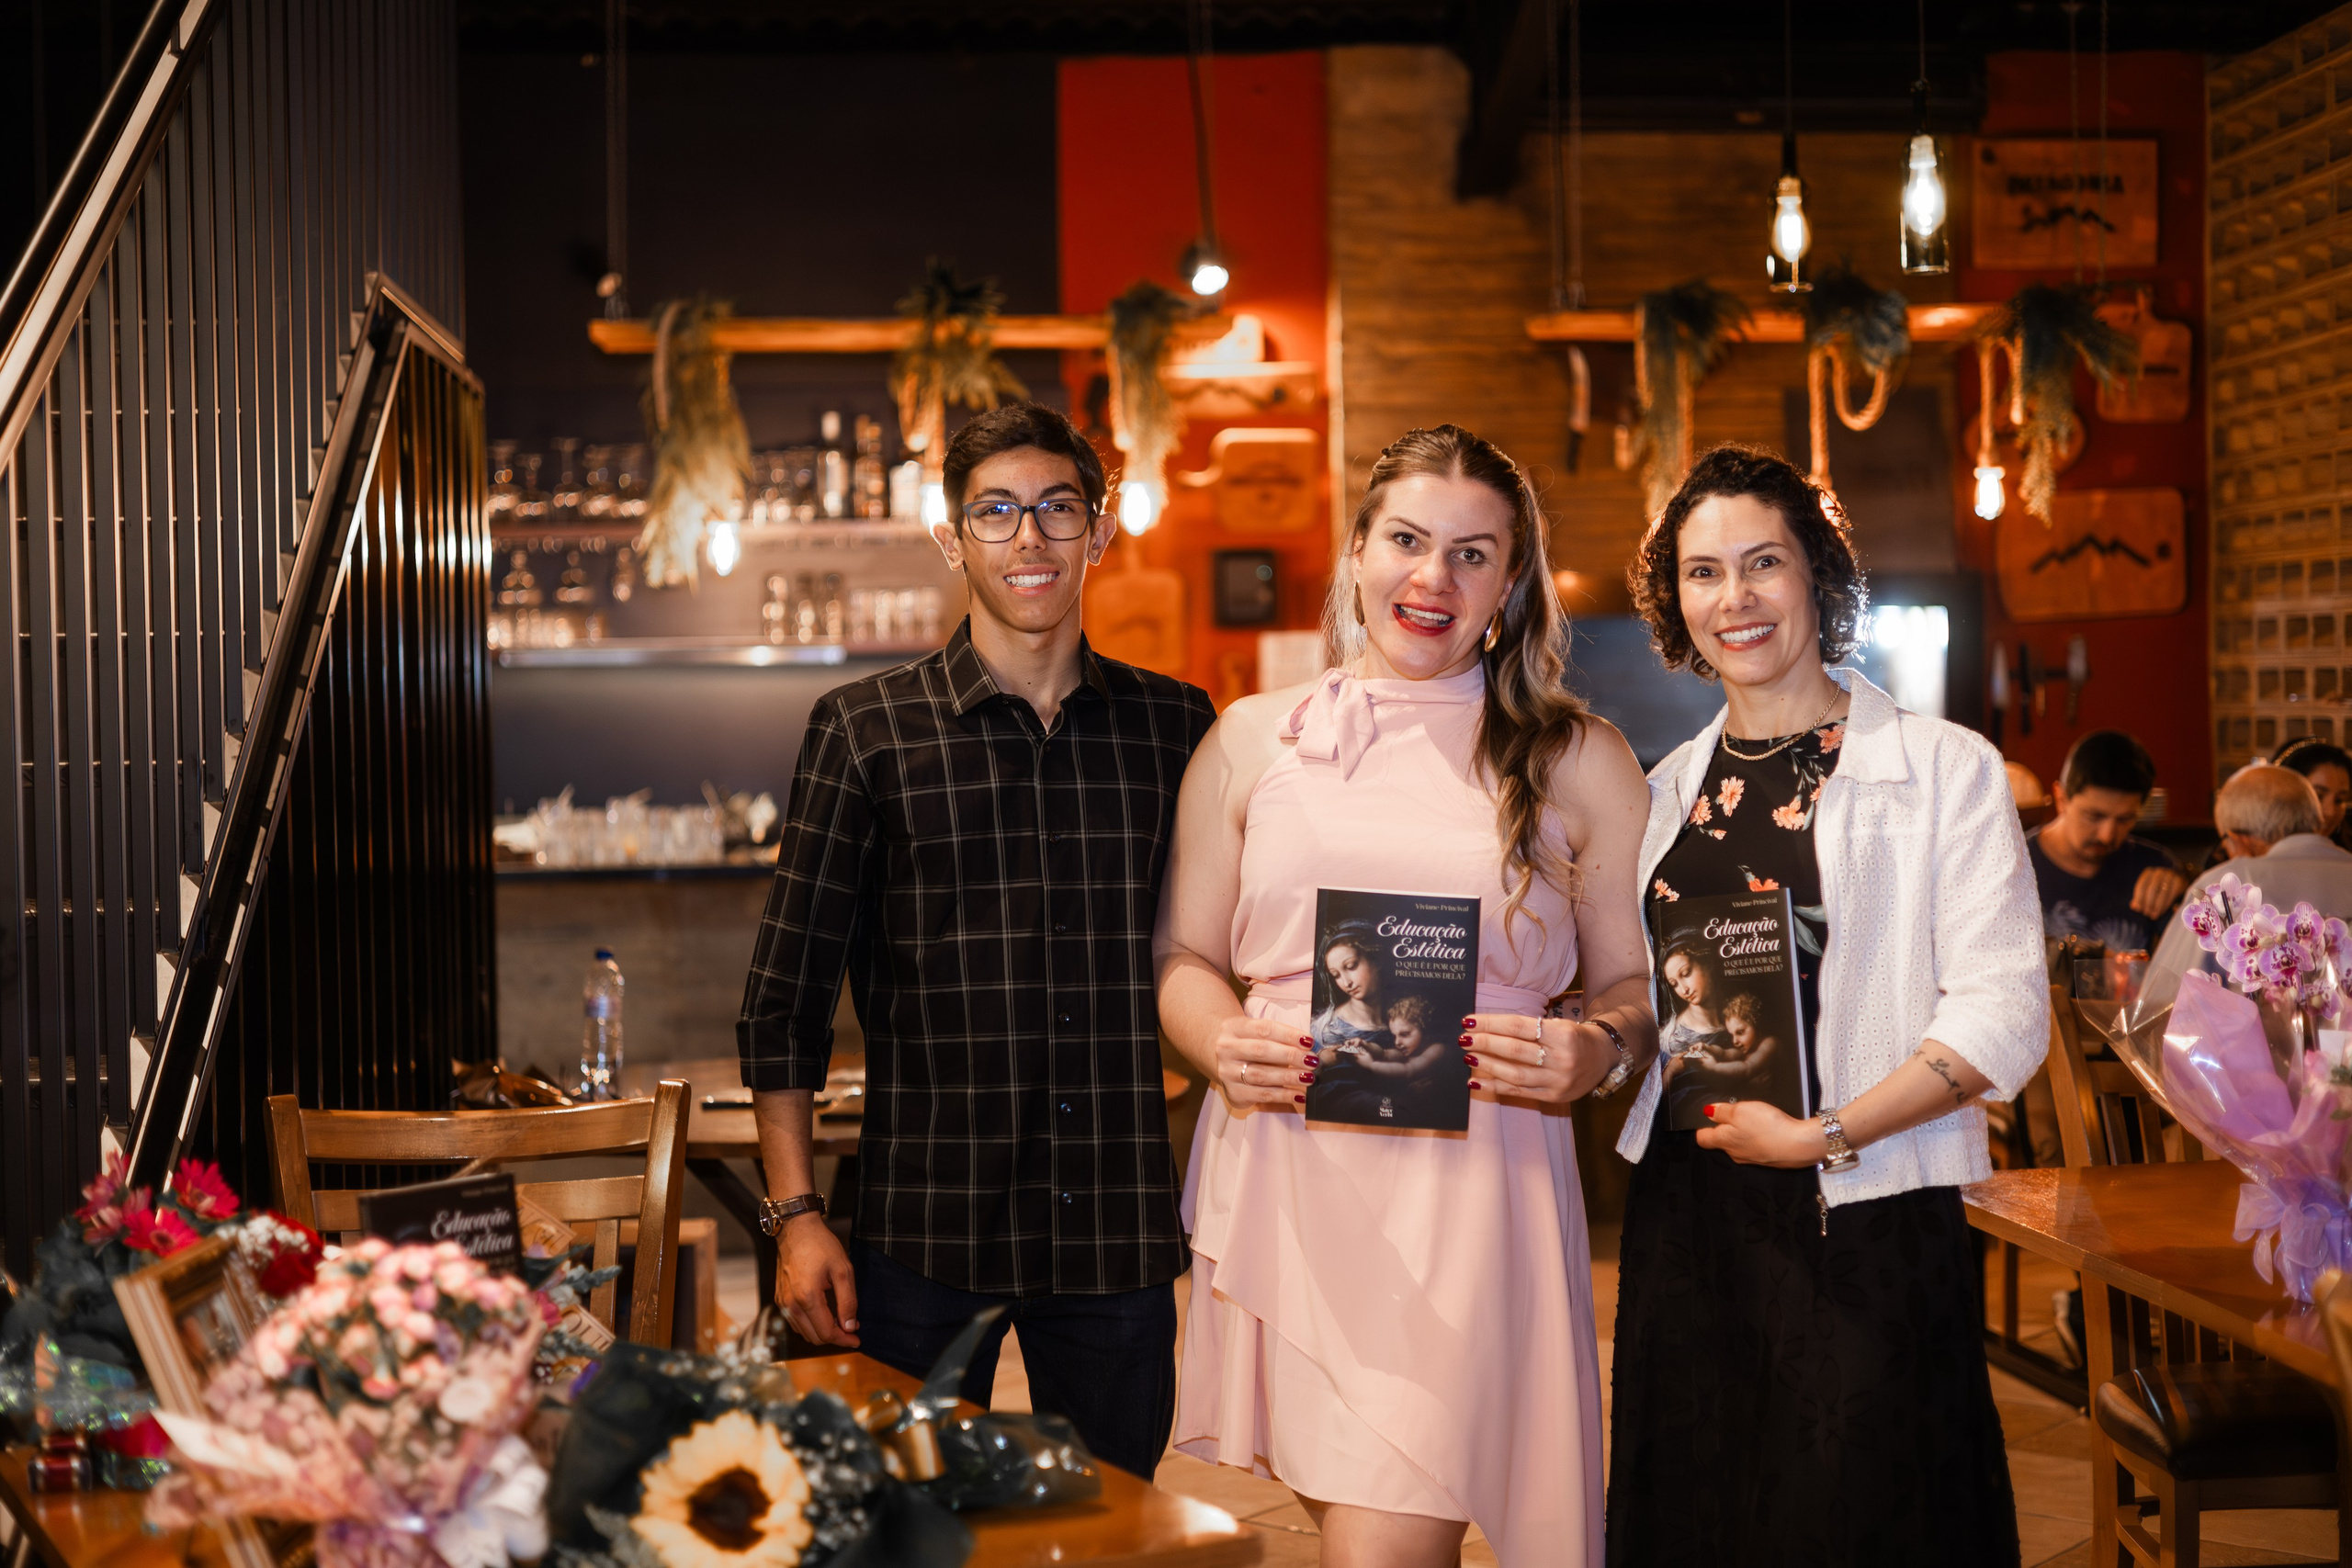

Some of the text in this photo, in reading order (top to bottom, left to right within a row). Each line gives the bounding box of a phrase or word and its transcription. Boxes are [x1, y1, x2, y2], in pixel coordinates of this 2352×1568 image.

[1416, 903, 1440, 911] Viviane
[1377, 916, 1467, 943] Educação
[1703, 917, 1780, 939] Educação
[1393, 937, 1466, 960] Estética
[1719, 936, 1781, 958] Estética
[1403, 962, 1419, 970] QUE
[1433, 963, 1449, 971] POR
[1450, 964, 1465, 972] QUE
[1724, 964, 1783, 976] PRECISAMOS DELA?
[1730, 959, 1744, 968] QUE
[1755, 956, 1769, 965] POR
[1769, 955, 1782, 964] QUE
[1395, 969, 1466, 980] PRECISAMOS DELA?
[430, 1207, 512, 1241] Educação
